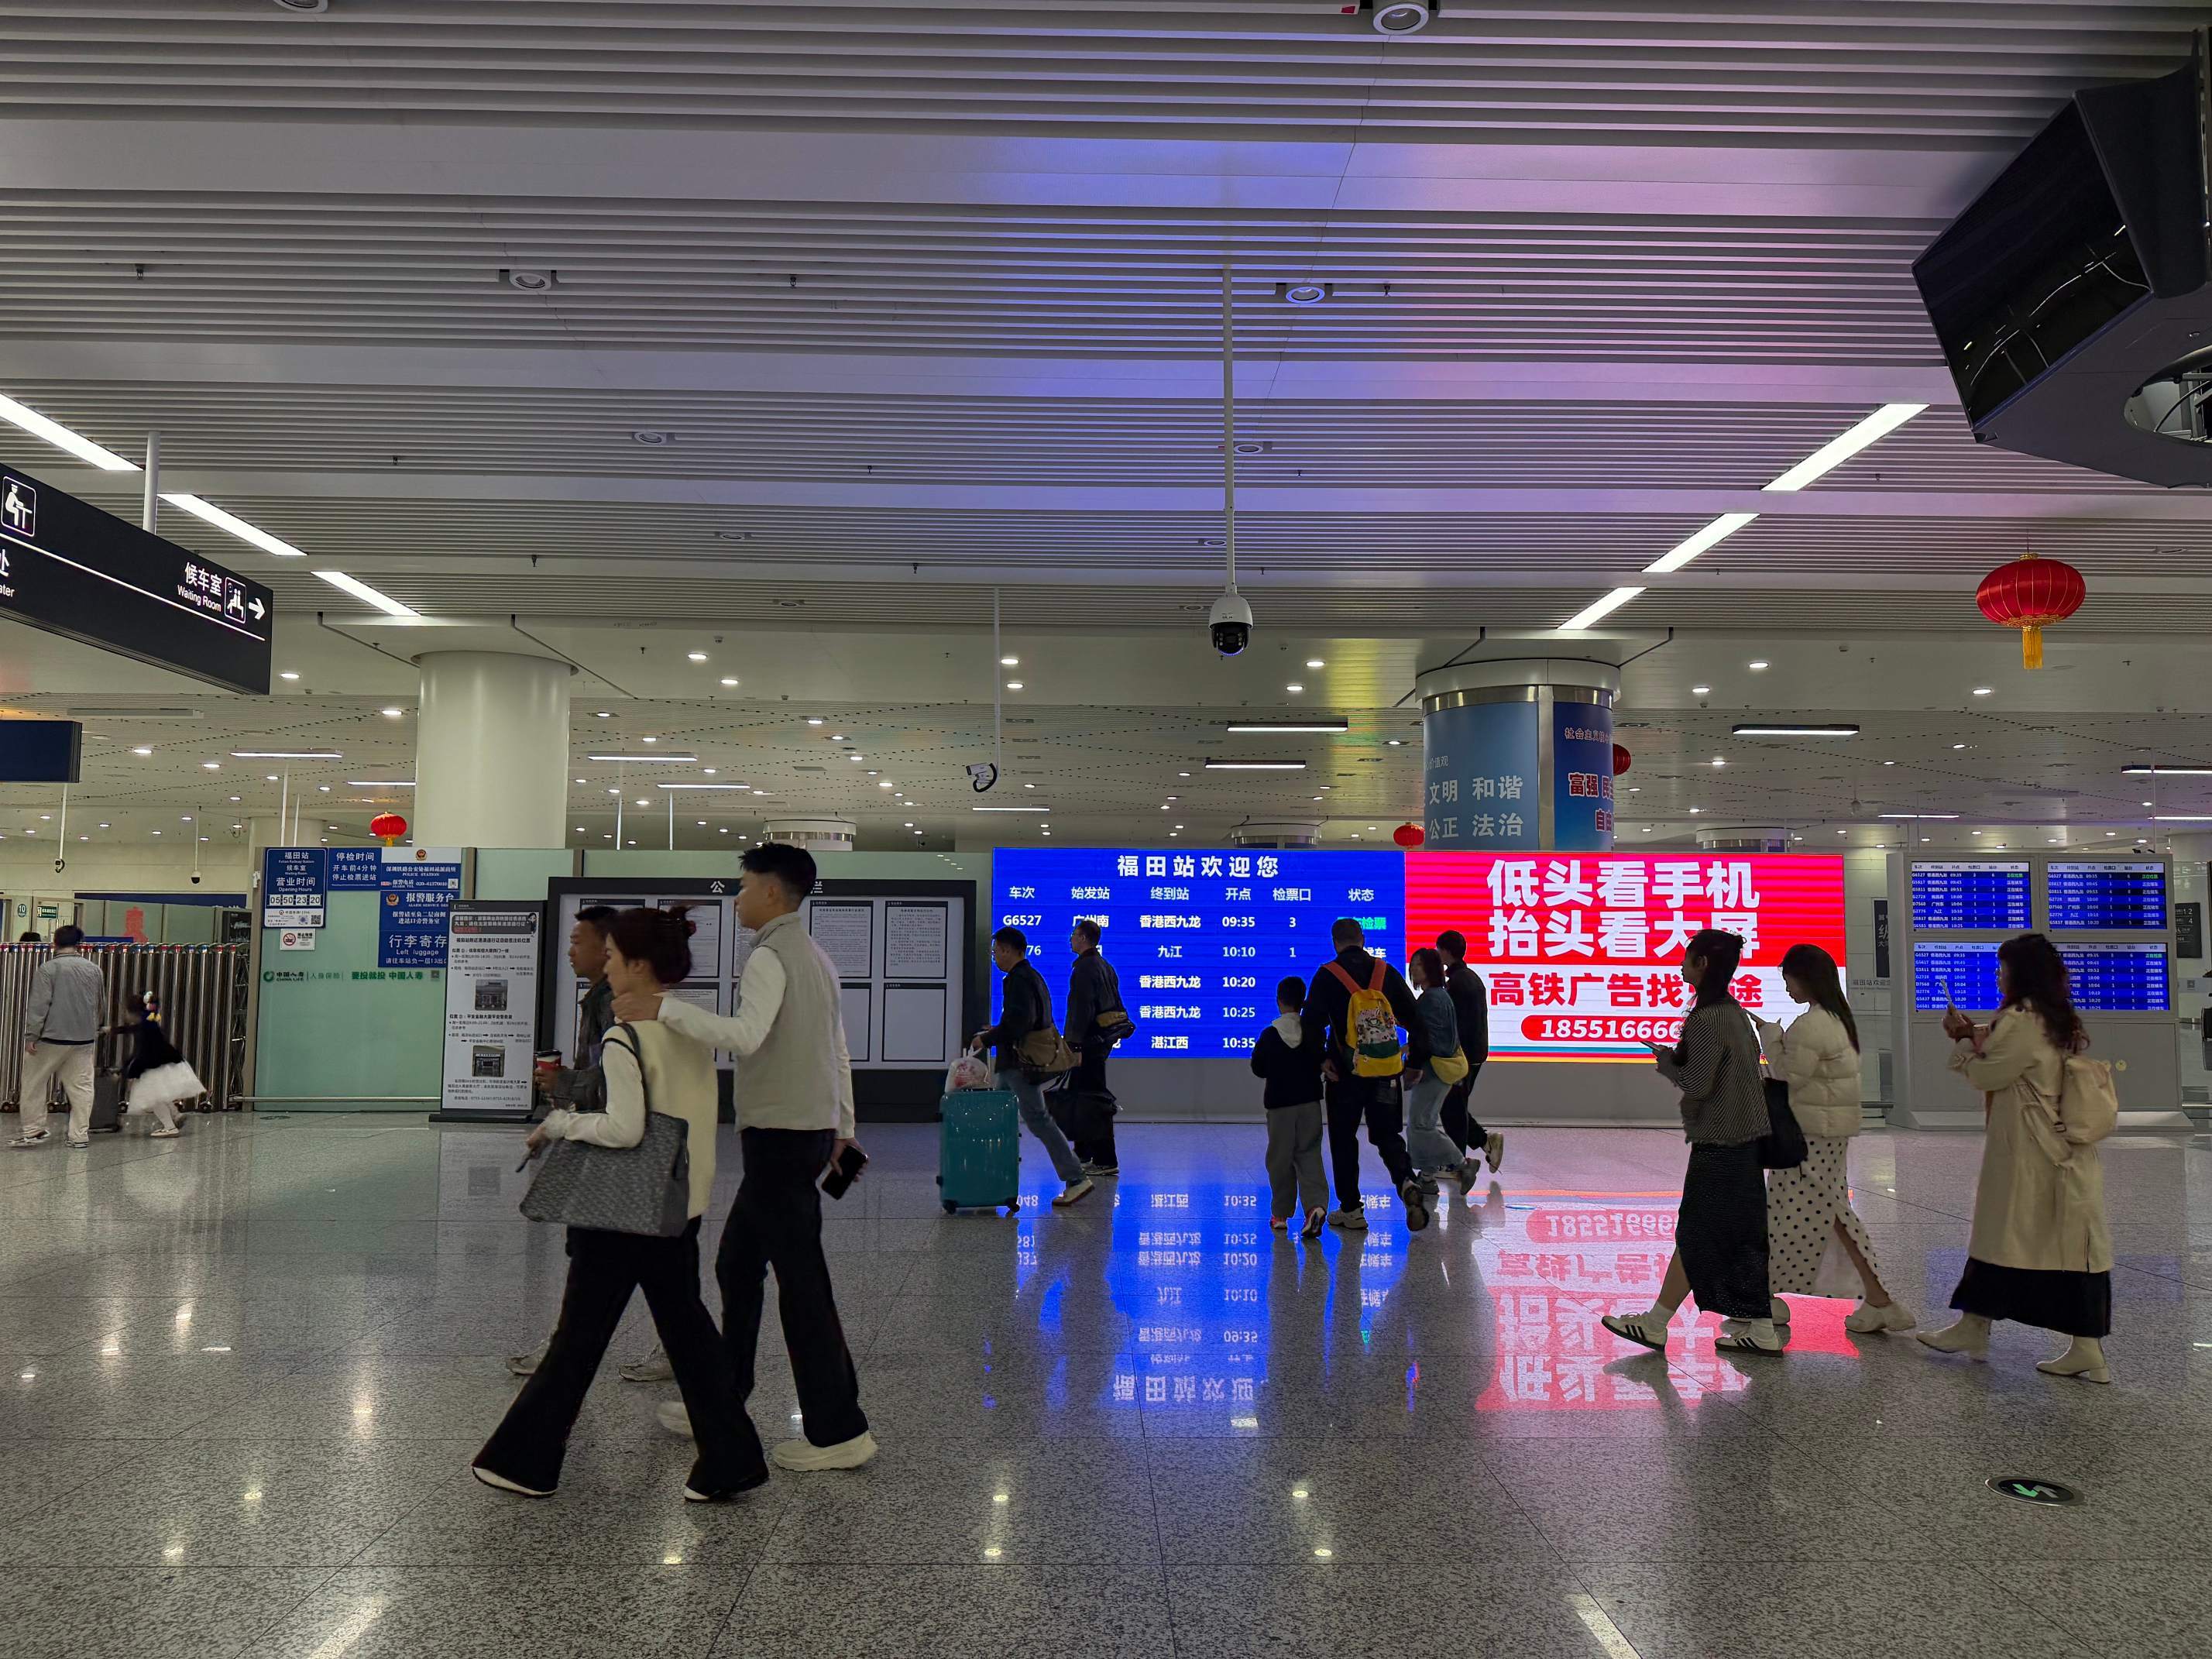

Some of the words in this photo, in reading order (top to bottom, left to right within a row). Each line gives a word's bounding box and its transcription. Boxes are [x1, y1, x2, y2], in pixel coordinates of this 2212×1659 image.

[185, 562, 222, 597] 候车室
[177, 584, 201, 606] Waiting
[203, 596, 222, 612] Room
[1429, 779, 1458, 805] 文明
[1472, 775, 1523, 801] 和谐
[1568, 771, 1599, 798] 富强
[1429, 817, 1459, 840] 公正
[1472, 812, 1523, 837] 法治
[336, 852, 374, 861] 停检时间
[1118, 855, 1279, 878] 福田站欢迎您
[276, 877, 315, 886] 营业时间
[1487, 860, 1760, 908] 低头看手机
[1009, 886, 1035, 899] 车次
[1071, 887, 1110, 899] 始发站
[1150, 887, 1190, 901] 终到站
[1225, 888, 1251, 901] 开点
[1273, 888, 1311, 902] 检票口
[1348, 888, 1374, 902] 状态
[1003, 915, 1042, 926] G6527
[1140, 915, 1201, 928] 香港西九龙
[1222, 917, 1255, 927] 09:35
[1289, 917, 1296, 928] 3
[389, 934, 447, 948] 行李寄存
[1158, 946, 1183, 958] 九江
[1222, 947, 1255, 957] 10:10
[1290, 947, 1296, 957] 1
[352, 971, 386, 980] 要投就投
[389, 971, 423, 980] 中国人寿
[1139, 975, 1201, 988] 香港西九龙
[1222, 977, 1255, 988] 10:20
[1489, 972, 1763, 1008] 高铁广告找途
[1139, 1005, 1201, 1018] 香港西九龙
[1222, 1007, 1255, 1018] 10:25
[1151, 1036, 1189, 1049] 湛江西
[1222, 1037, 1255, 1048] 10:35
